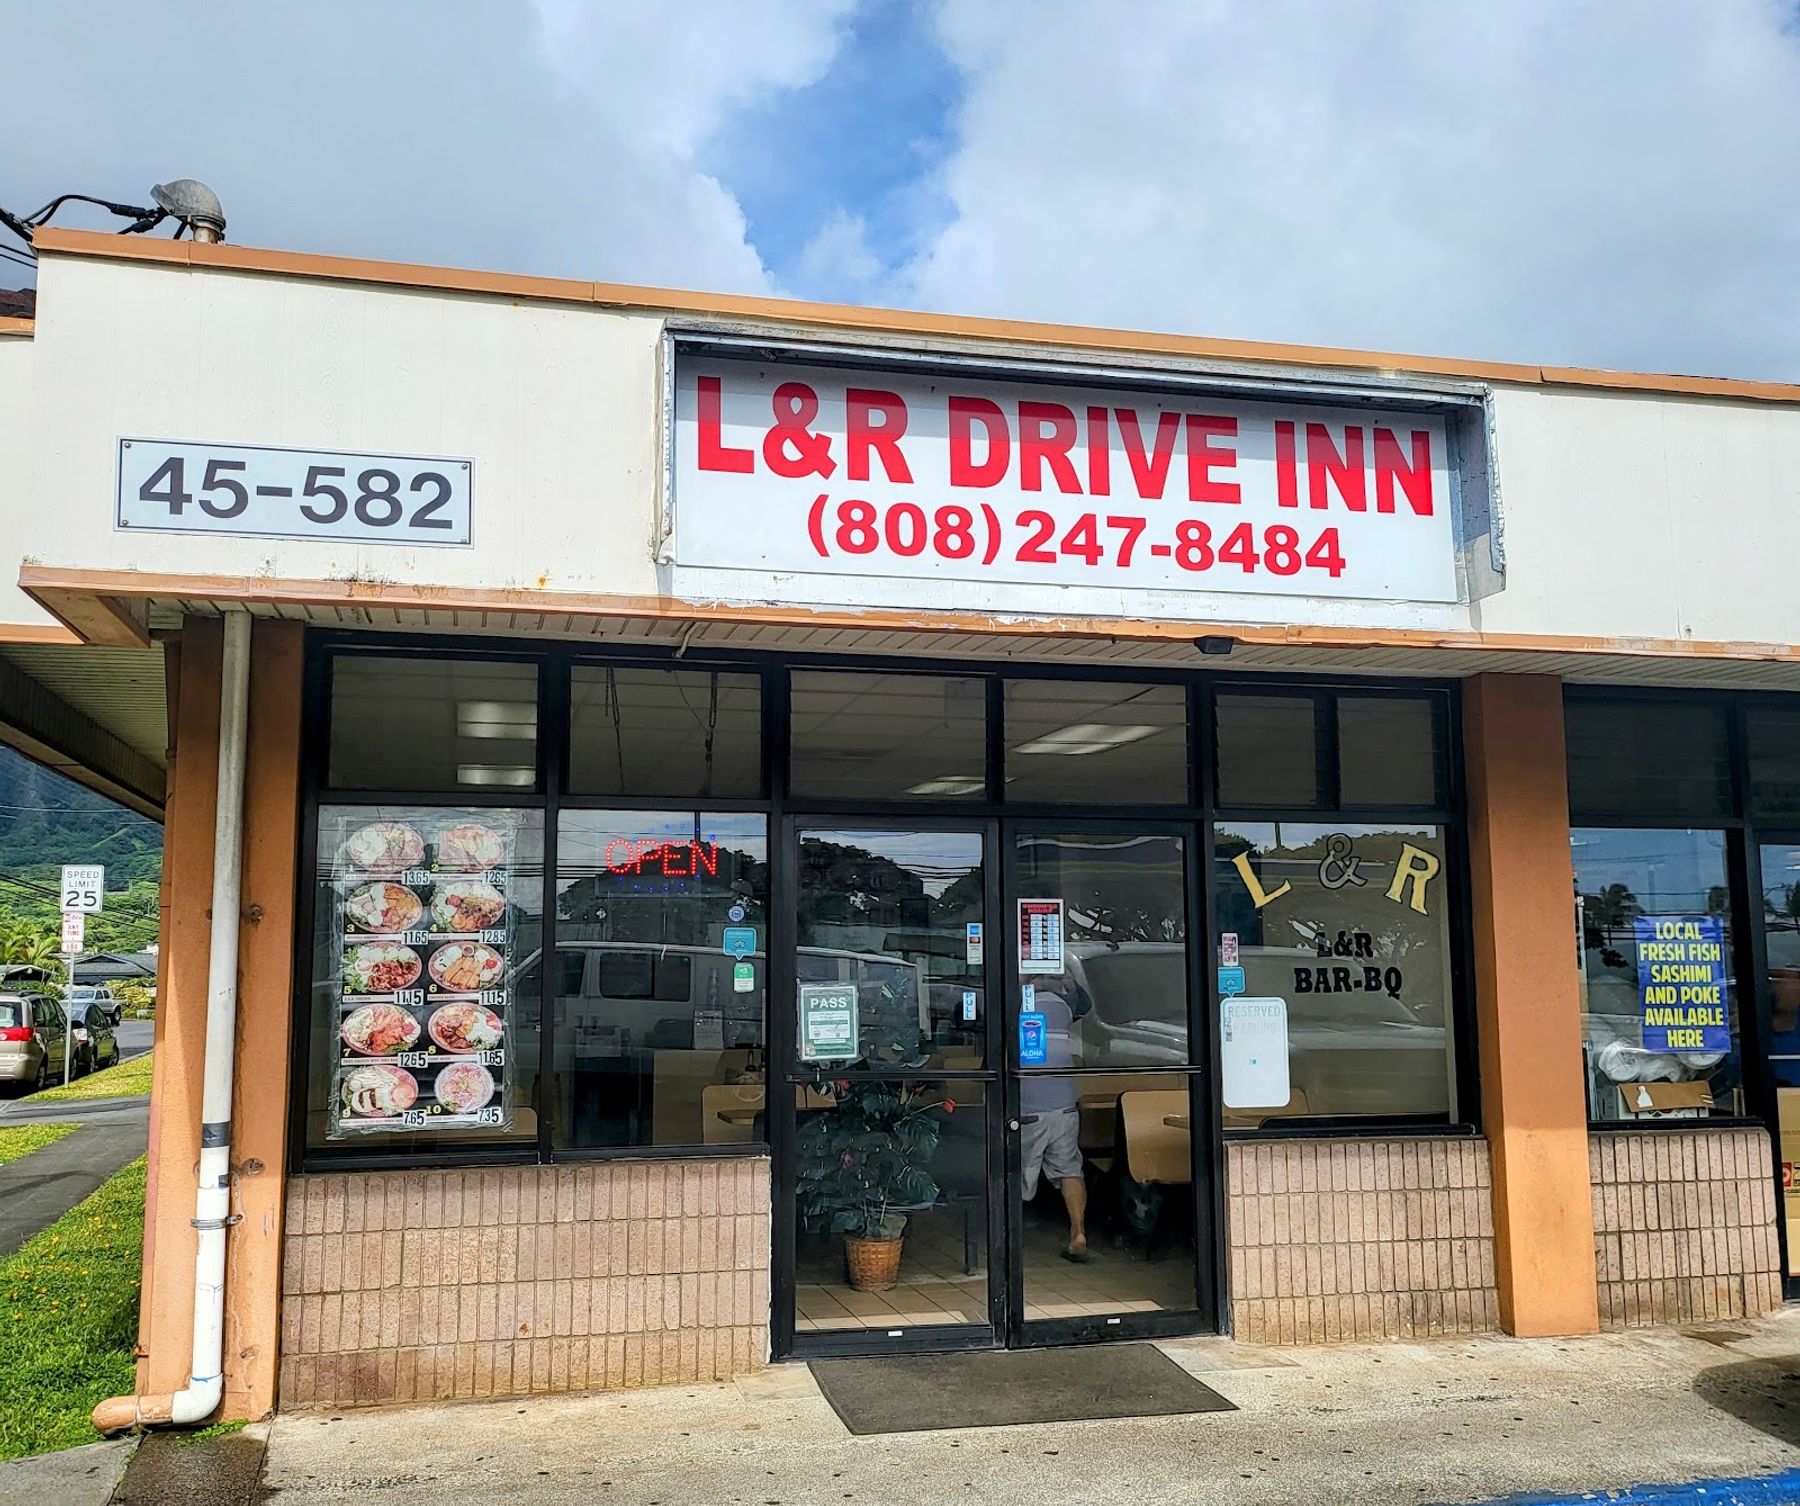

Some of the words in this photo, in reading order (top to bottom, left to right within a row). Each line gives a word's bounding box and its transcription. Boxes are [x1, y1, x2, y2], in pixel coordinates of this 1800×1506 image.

[697, 375, 913, 484] L&R
[948, 395, 1243, 505] DRIVE
[1274, 419, 1434, 516] INN
[139, 456, 454, 530] 45-582
[807, 492, 1002, 566] (808)
[1015, 508, 1347, 578] 247-8484
[605, 838, 718, 876] OPEN
[67, 871, 100, 879] SPEED
[430, 863, 440, 872] 2
[66, 890, 97, 907] 25
[346, 923, 356, 933] 3
[430, 923, 439, 932] 4
[1655, 921, 1703, 940] LOCAL
[1316, 930, 1374, 958] L&R
[1639, 943, 1685, 962] FRESH
[1688, 943, 1721, 962] FISH
[1294, 966, 1402, 998] BAR-BQ
[1650, 965, 1712, 983] SASHIMI
[343, 985, 352, 995] 5
[428, 984, 438, 993] 6
[1645, 986, 1679, 1005] AND
[1681, 986, 1721, 1005] POKE
[810, 997, 848, 1009] PASS
[1228, 1005, 1281, 1018] RESERVED
[1645, 1007, 1724, 1026] AVAILABLE
[1667, 1029, 1704, 1048] HERE
[343, 1048, 351, 1057] 7
[428, 1045, 437, 1055] 8
[342, 1107, 352, 1118] 9
[403, 1110, 425, 1125] 7.65
[426, 1105, 442, 1114] 10
